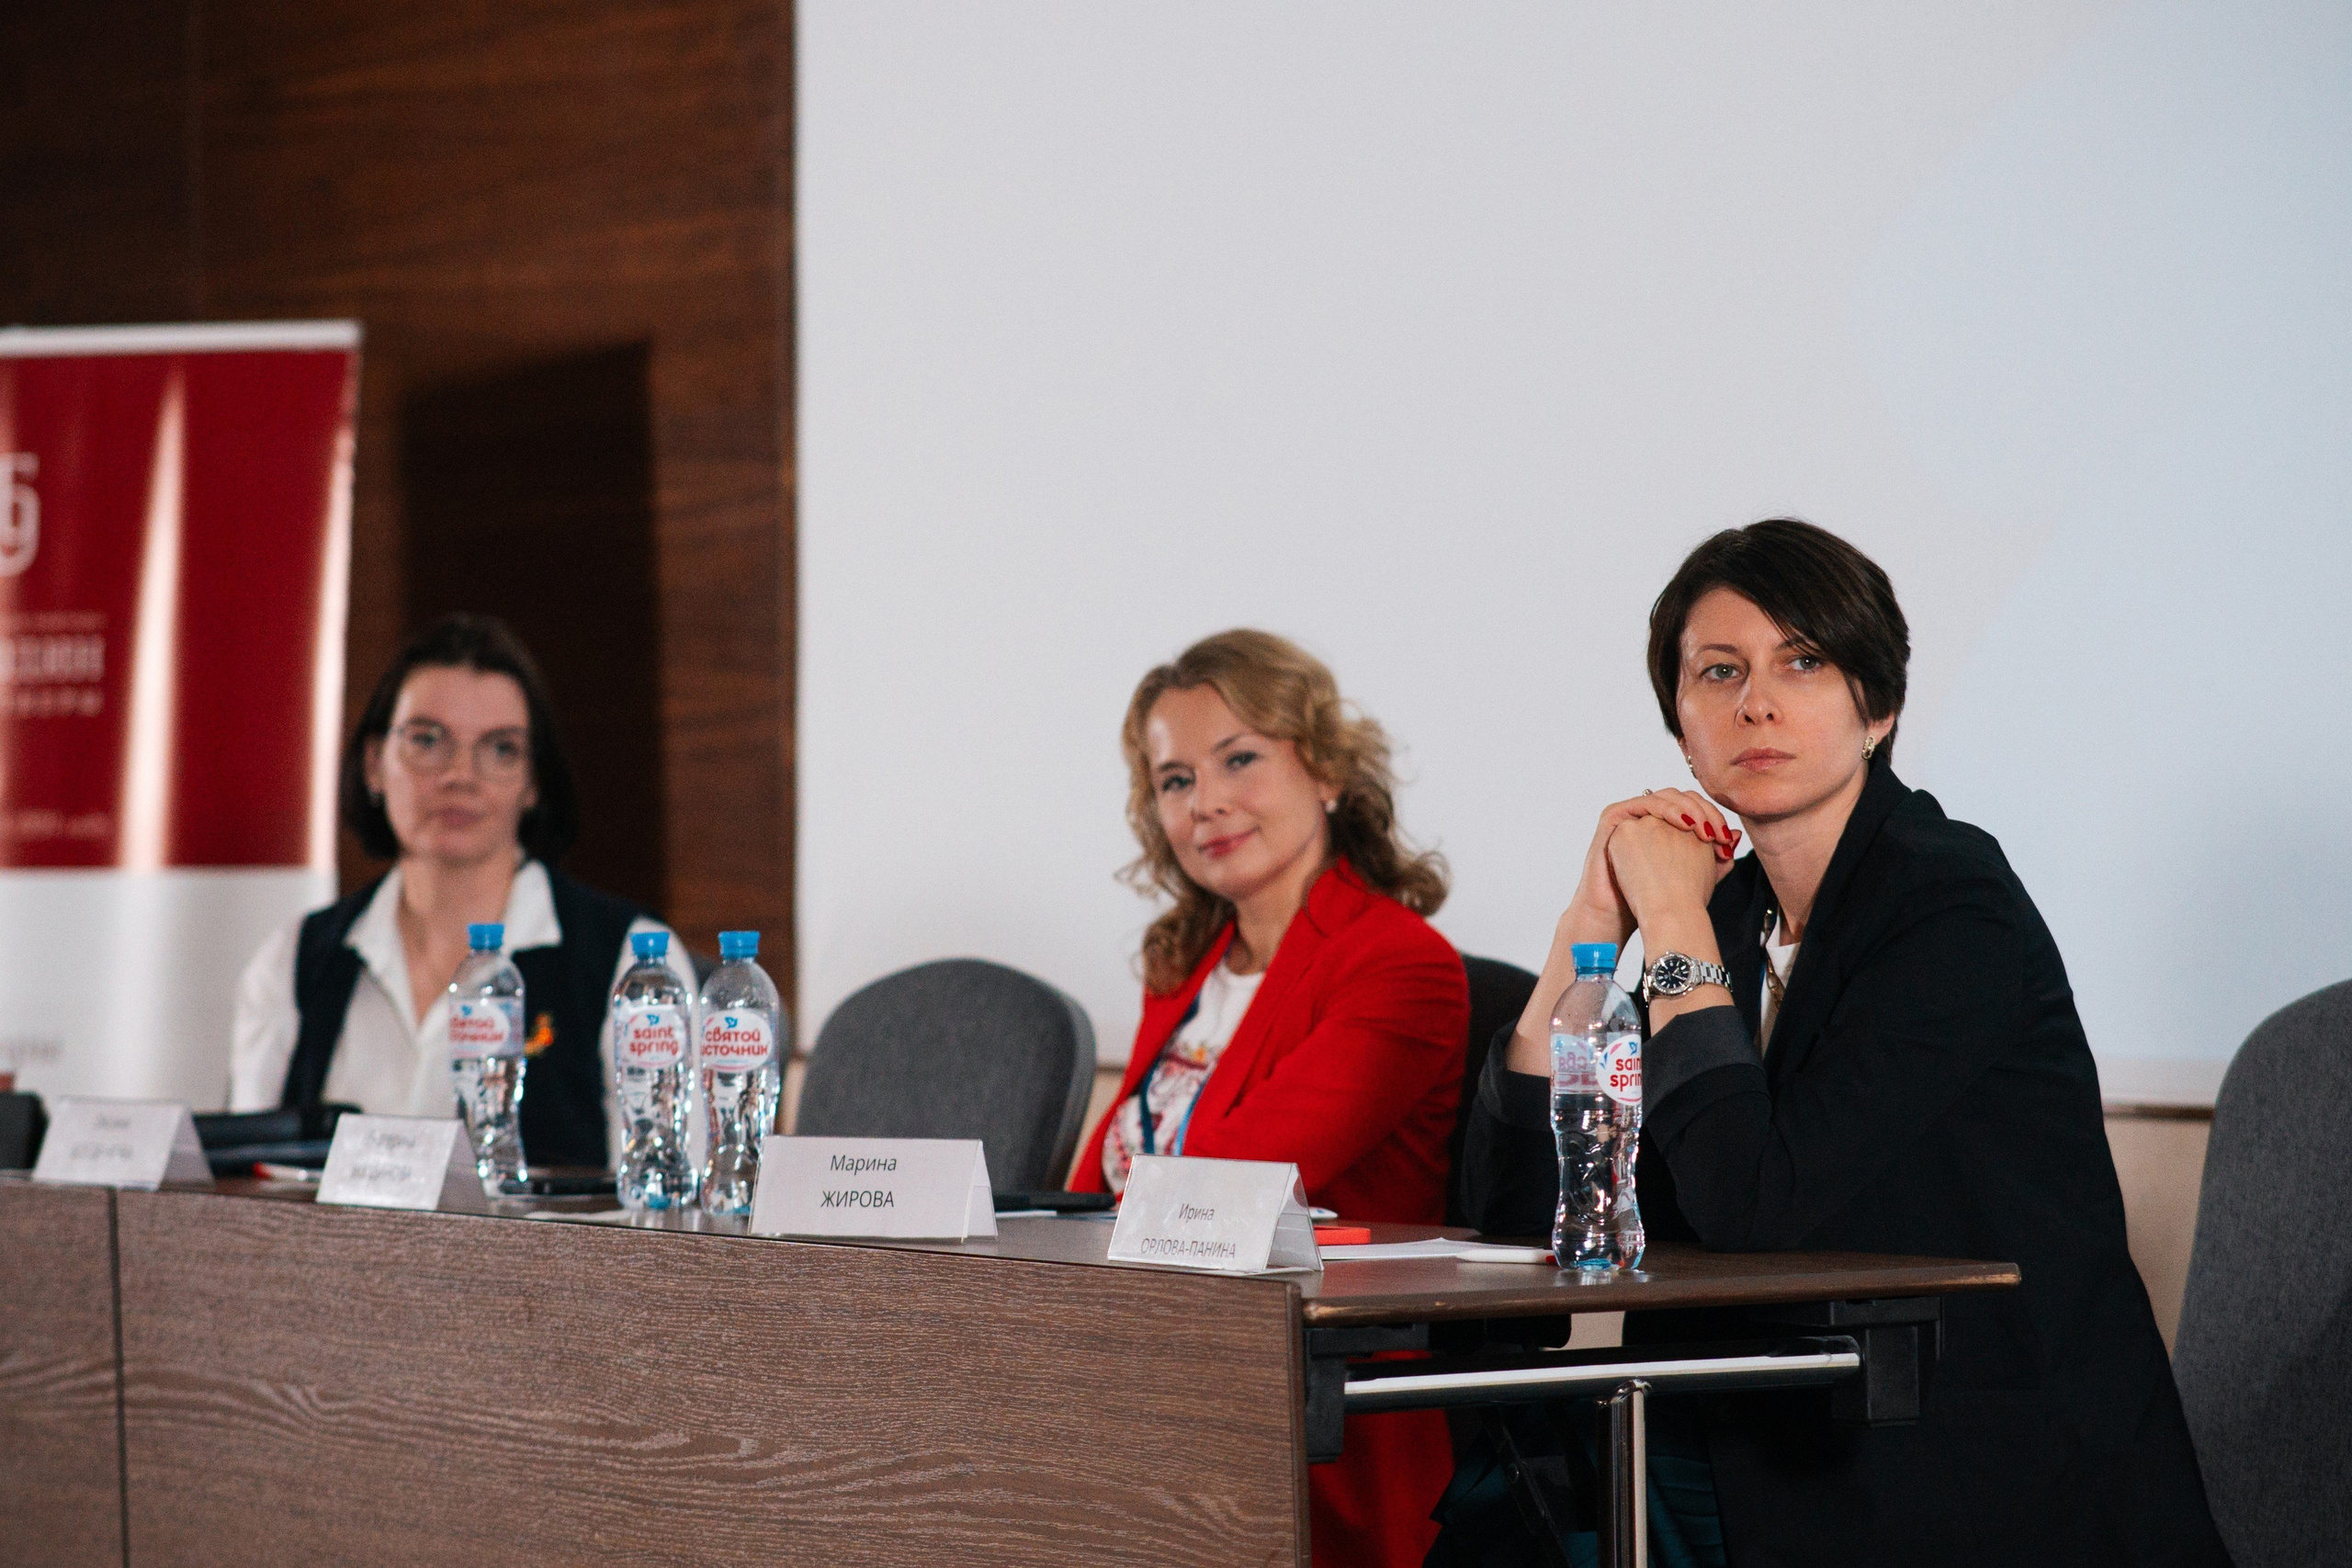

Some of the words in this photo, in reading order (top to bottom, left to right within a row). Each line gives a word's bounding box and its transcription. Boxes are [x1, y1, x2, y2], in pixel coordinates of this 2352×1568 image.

[633, 1026, 673, 1039] saint
[705, 1027, 761, 1043] святой
[629, 1040, 678, 1055] spring
[830, 1155, 898, 1176] Марина
[820, 1190, 895, 1208] ЖИРОВА
[1178, 1203, 1216, 1223] Ирина
[1140, 1237, 1237, 1258] ОРЛОВА-ПАНИНА
